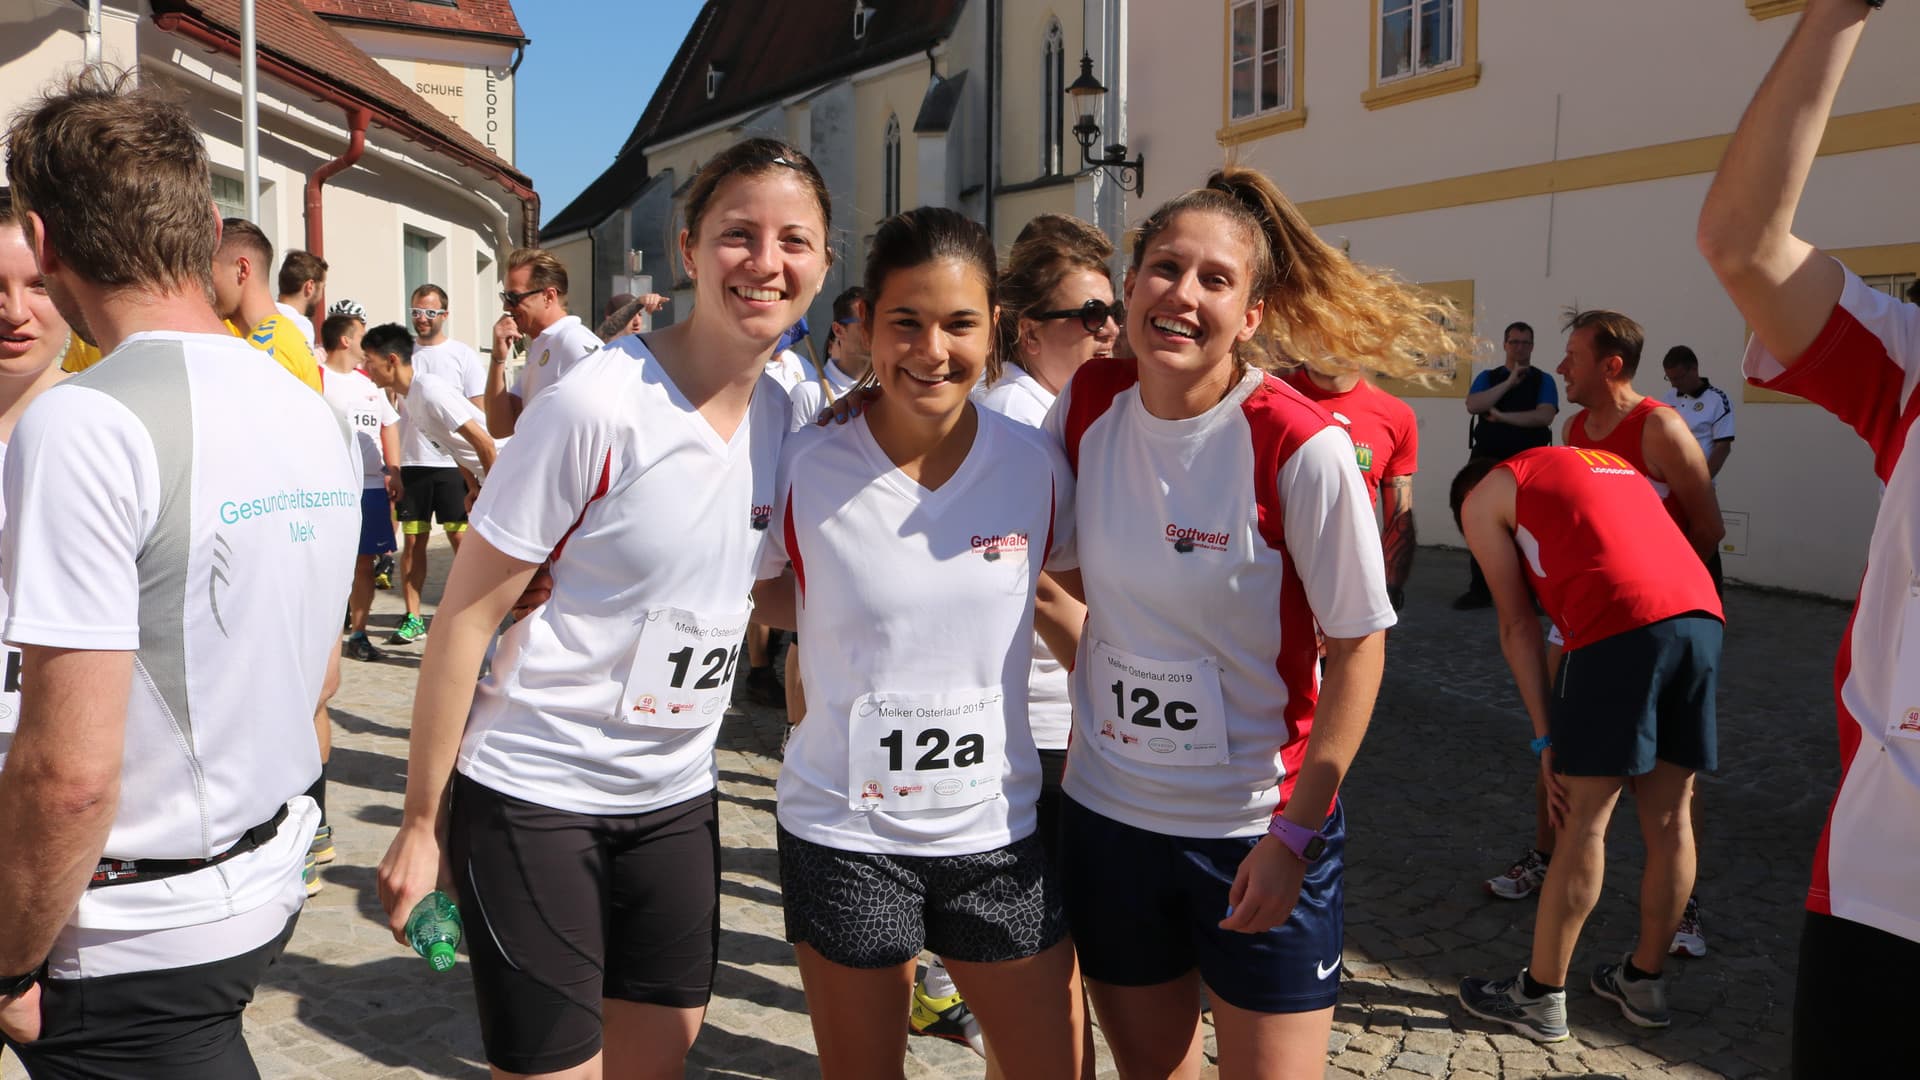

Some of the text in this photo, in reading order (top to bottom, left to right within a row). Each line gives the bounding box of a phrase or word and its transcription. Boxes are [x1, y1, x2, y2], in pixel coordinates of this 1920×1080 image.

[416, 83, 463, 96] SCHUHE
[354, 414, 377, 427] 16b
[970, 533, 1028, 548] Gottwald
[1166, 523, 1230, 546] Gottwald
[673, 621, 709, 638] Melker
[1128, 665, 1166, 681] Osterlauf
[1167, 673, 1193, 683] 2019
[878, 702, 984, 719] Melker Osterlauf 2019
[1111, 679, 1199, 731] 12c
[880, 728, 984, 772] 12a
